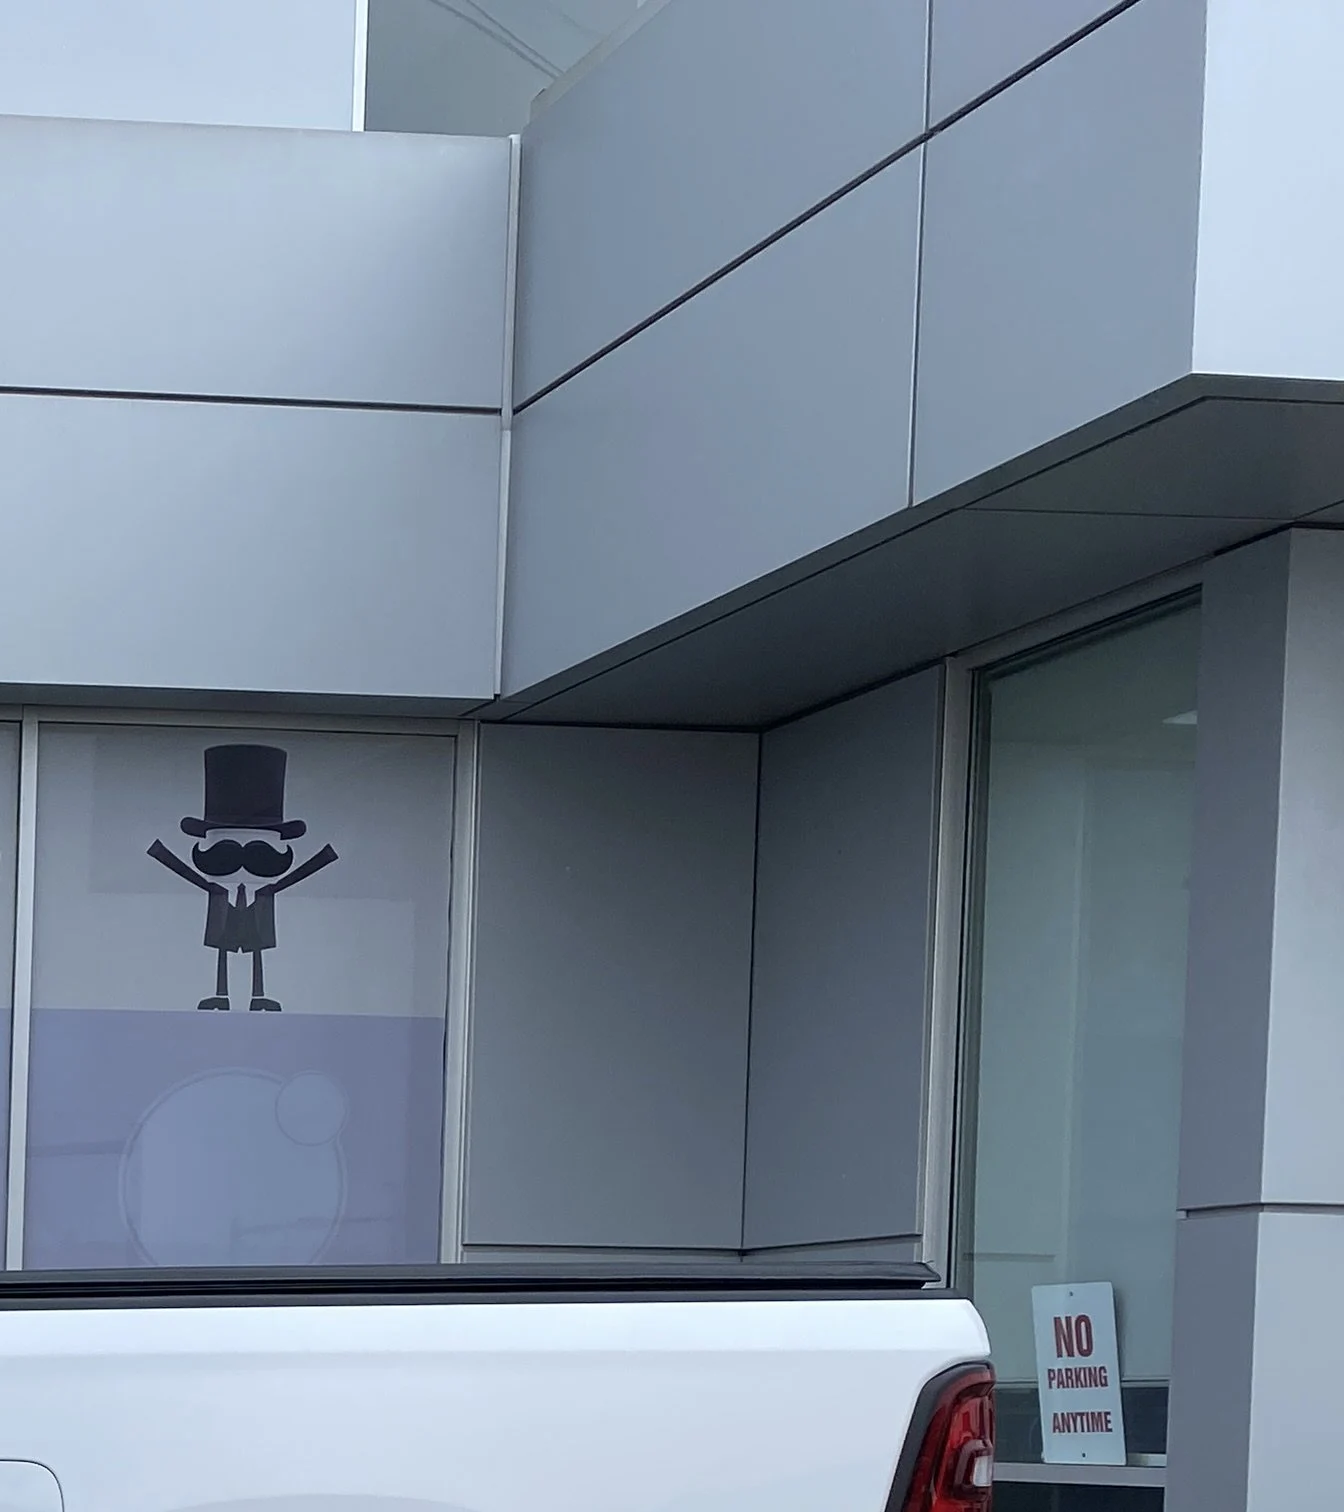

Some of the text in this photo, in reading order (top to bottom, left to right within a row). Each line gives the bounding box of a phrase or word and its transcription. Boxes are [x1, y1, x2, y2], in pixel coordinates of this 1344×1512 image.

[1053, 1314, 1094, 1358] NO
[1047, 1366, 1109, 1389] PARKING
[1052, 1411, 1113, 1434] ANYTIME
